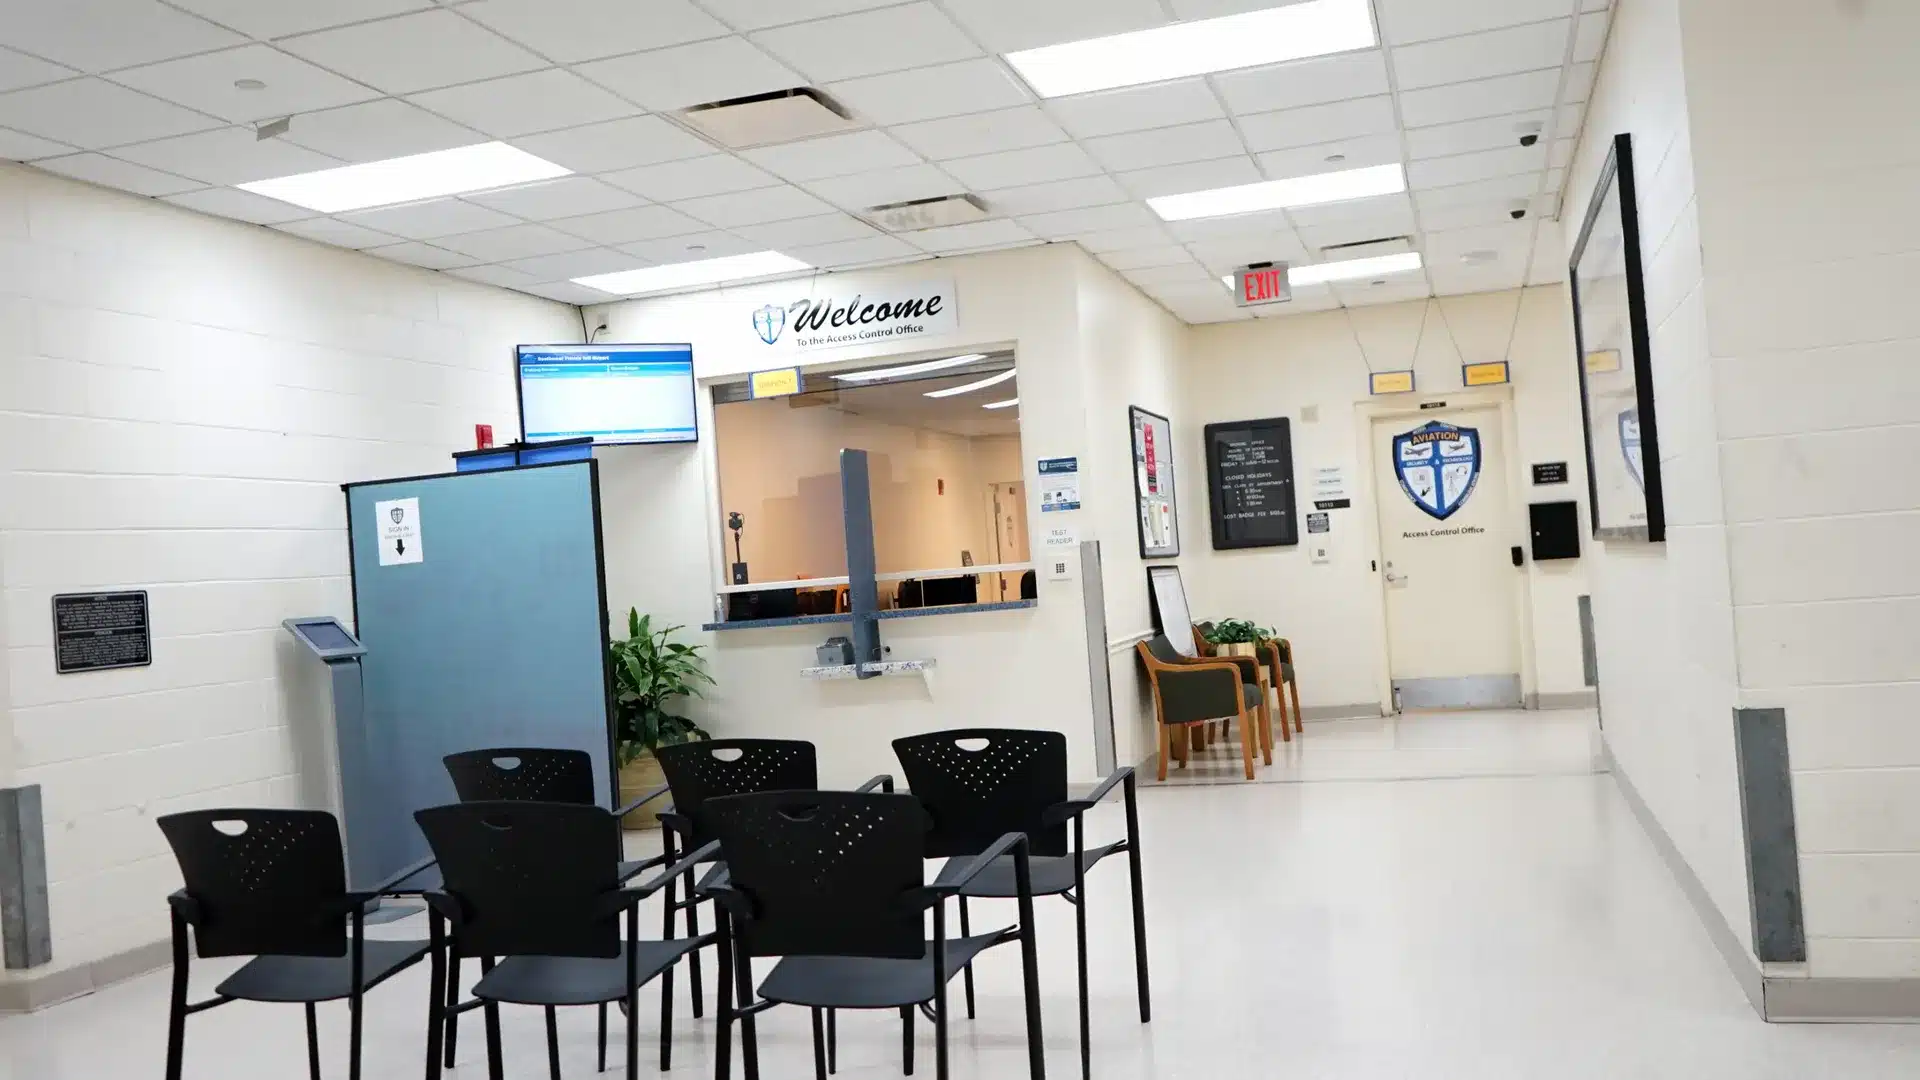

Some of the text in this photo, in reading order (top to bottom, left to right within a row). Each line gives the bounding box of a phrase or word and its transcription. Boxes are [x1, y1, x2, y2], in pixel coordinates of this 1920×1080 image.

[1244, 270, 1280, 301] EXIT
[788, 294, 943, 333] Welcome
[796, 324, 924, 347] To the Access Control Office
[1412, 431, 1459, 445] AVIATION
[1246, 471, 1272, 479] HOLIDAYS
[1238, 511, 1255, 519] BADGE
[1402, 526, 1485, 539] Access Control Office
[1046, 537, 1073, 545] READER
